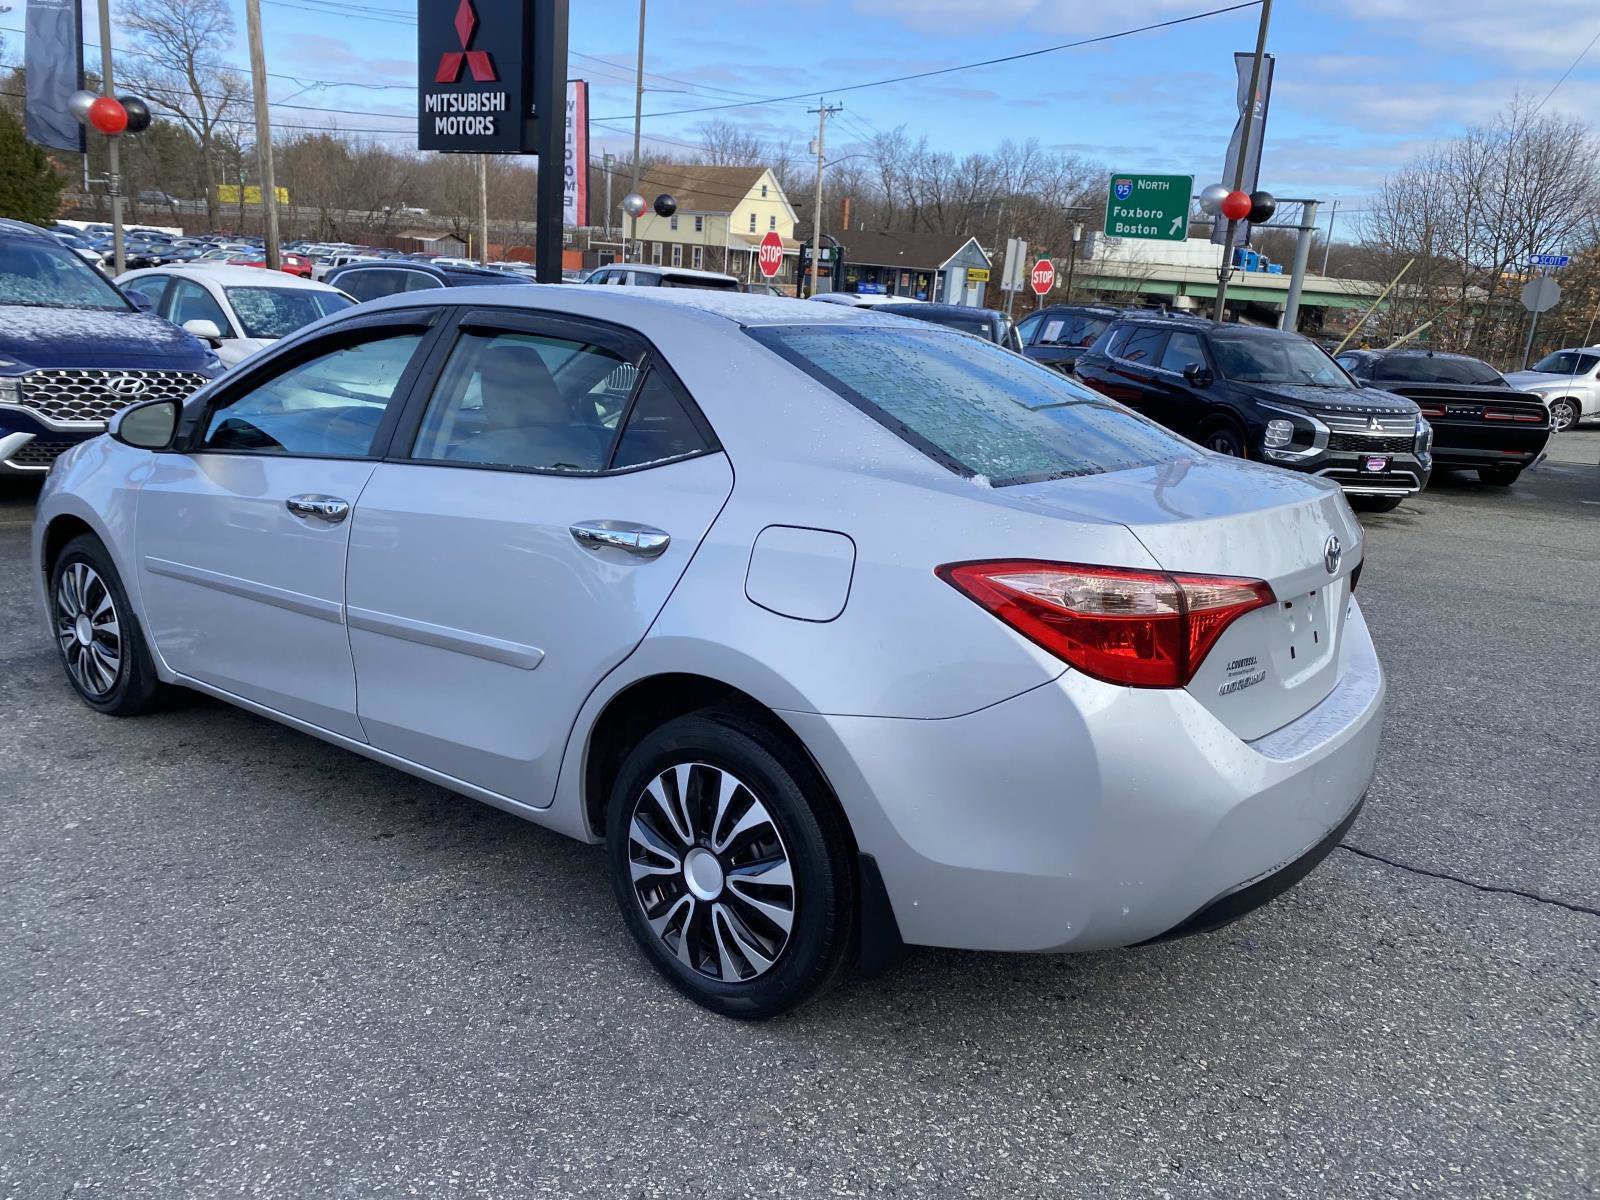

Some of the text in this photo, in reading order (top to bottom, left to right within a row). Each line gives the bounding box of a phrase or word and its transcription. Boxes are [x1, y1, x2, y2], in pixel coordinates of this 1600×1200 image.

[425, 92, 506, 112] MITSUBISHI
[435, 116, 494, 135] MOTORS
[1117, 185, 1130, 195] 95
[1113, 206, 1163, 218] Foxboro
[1115, 222, 1158, 235] Boston
[760, 244, 782, 263] STOP
[1033, 270, 1053, 284] STOP
